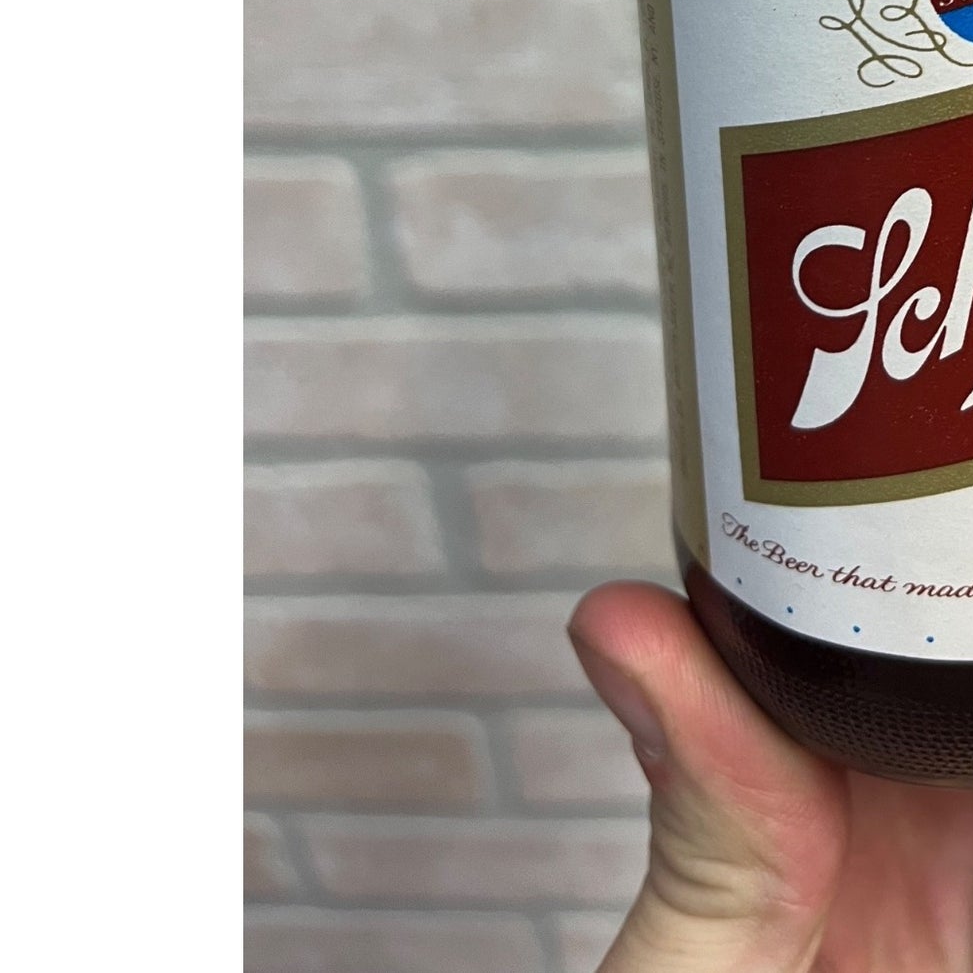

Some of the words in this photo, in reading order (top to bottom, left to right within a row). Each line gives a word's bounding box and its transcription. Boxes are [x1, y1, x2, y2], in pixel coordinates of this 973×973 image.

[721, 512, 761, 553] The
[761, 540, 824, 580] Beer
[829, 566, 896, 593] that
